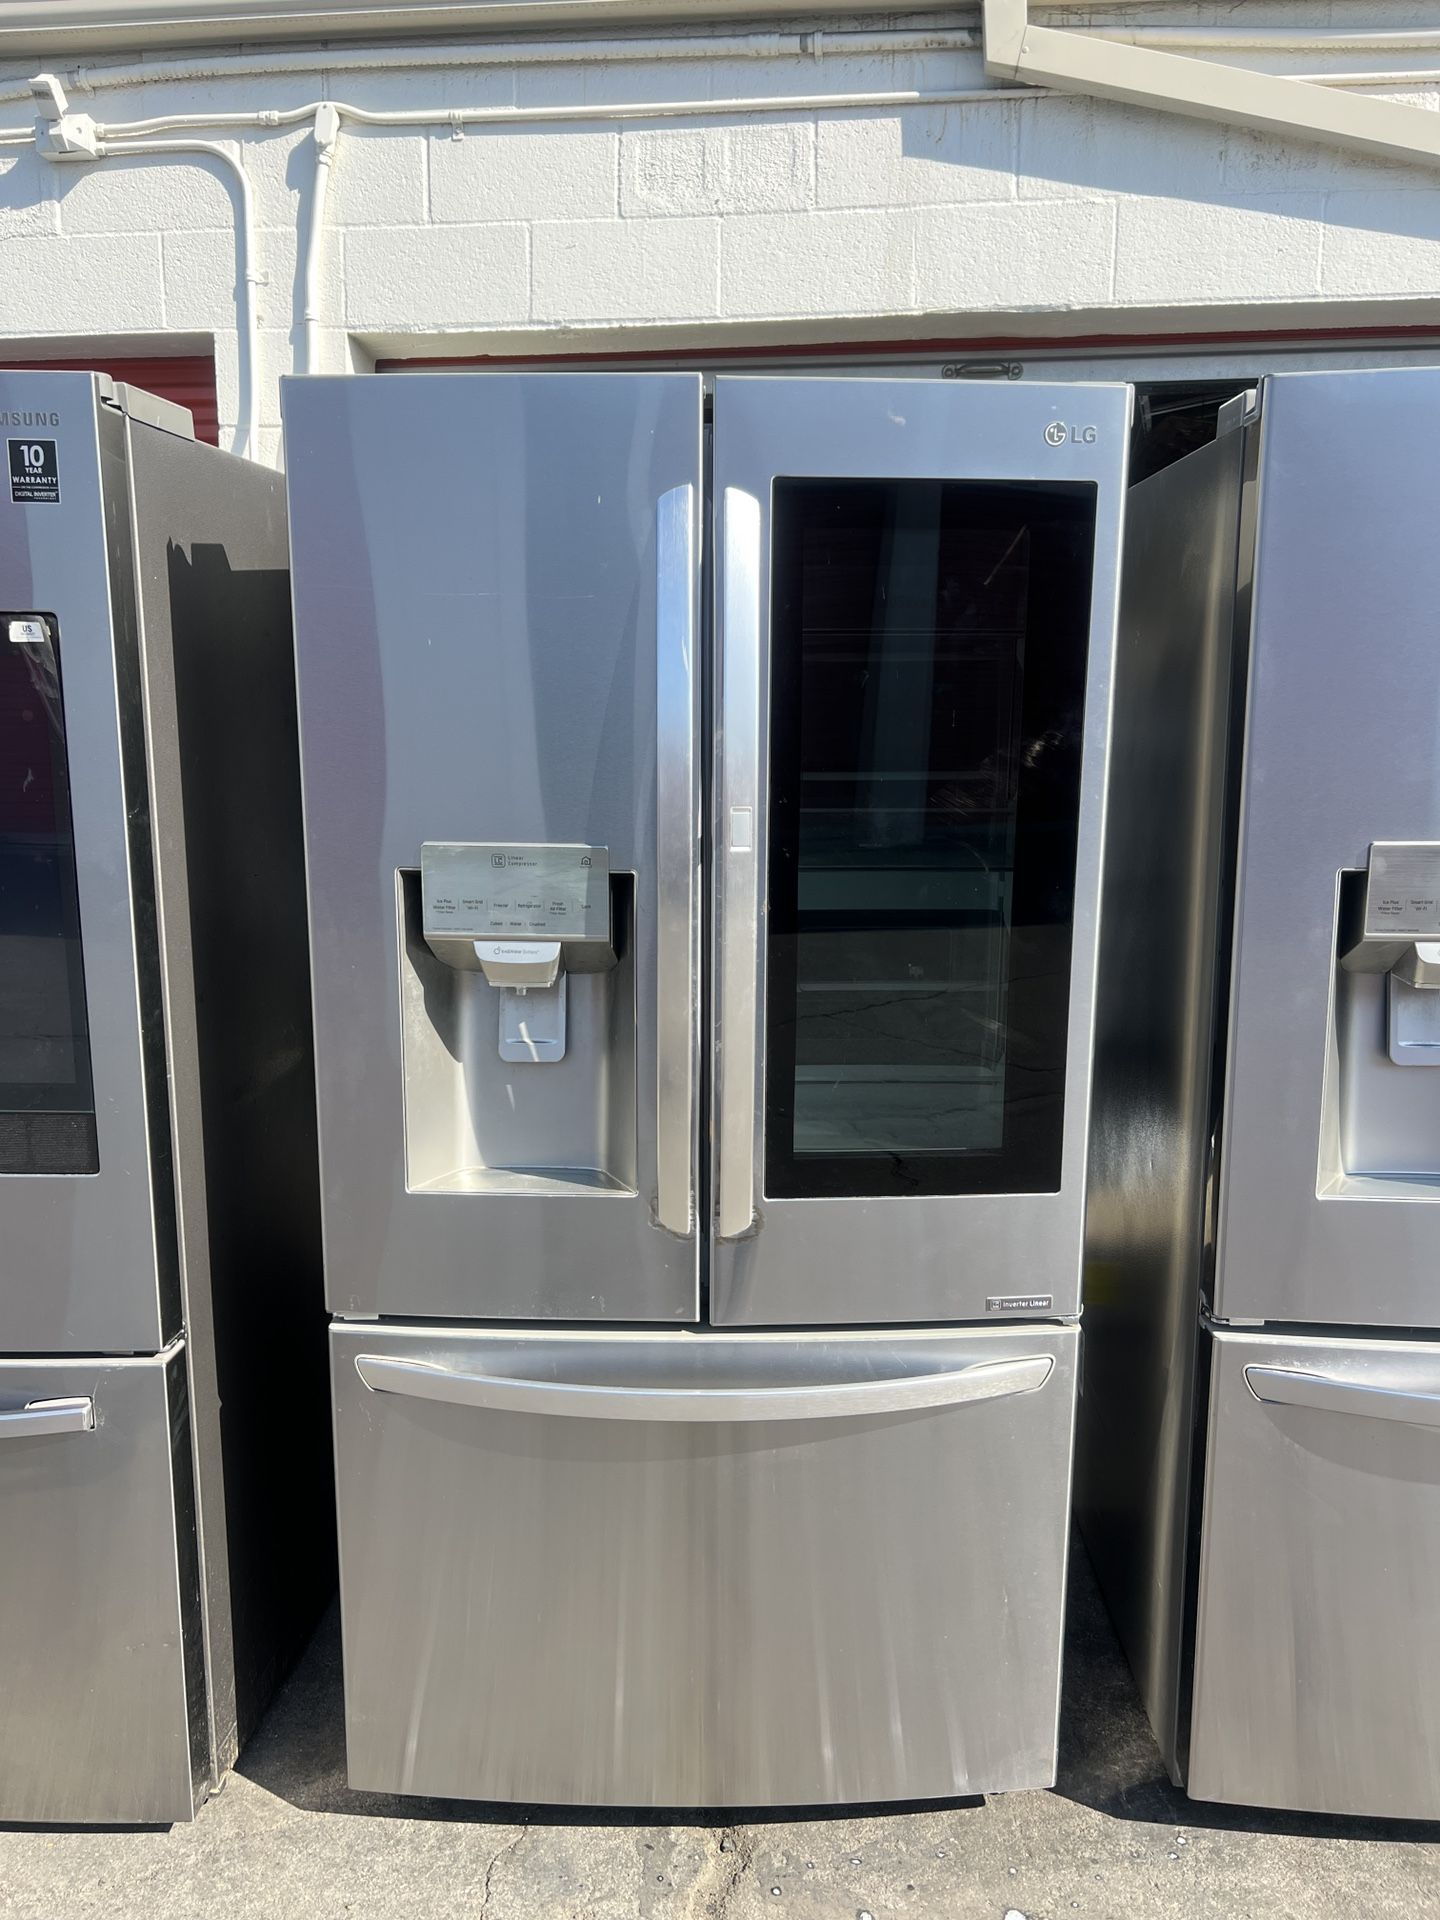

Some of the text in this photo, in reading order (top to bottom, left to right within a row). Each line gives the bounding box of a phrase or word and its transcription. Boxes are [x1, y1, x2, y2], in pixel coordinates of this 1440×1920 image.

[1071, 426, 1097, 444] LG
[20, 445, 45, 467] 10
[12, 476, 57, 484] WARRANTY
[22, 624, 33, 633] US
